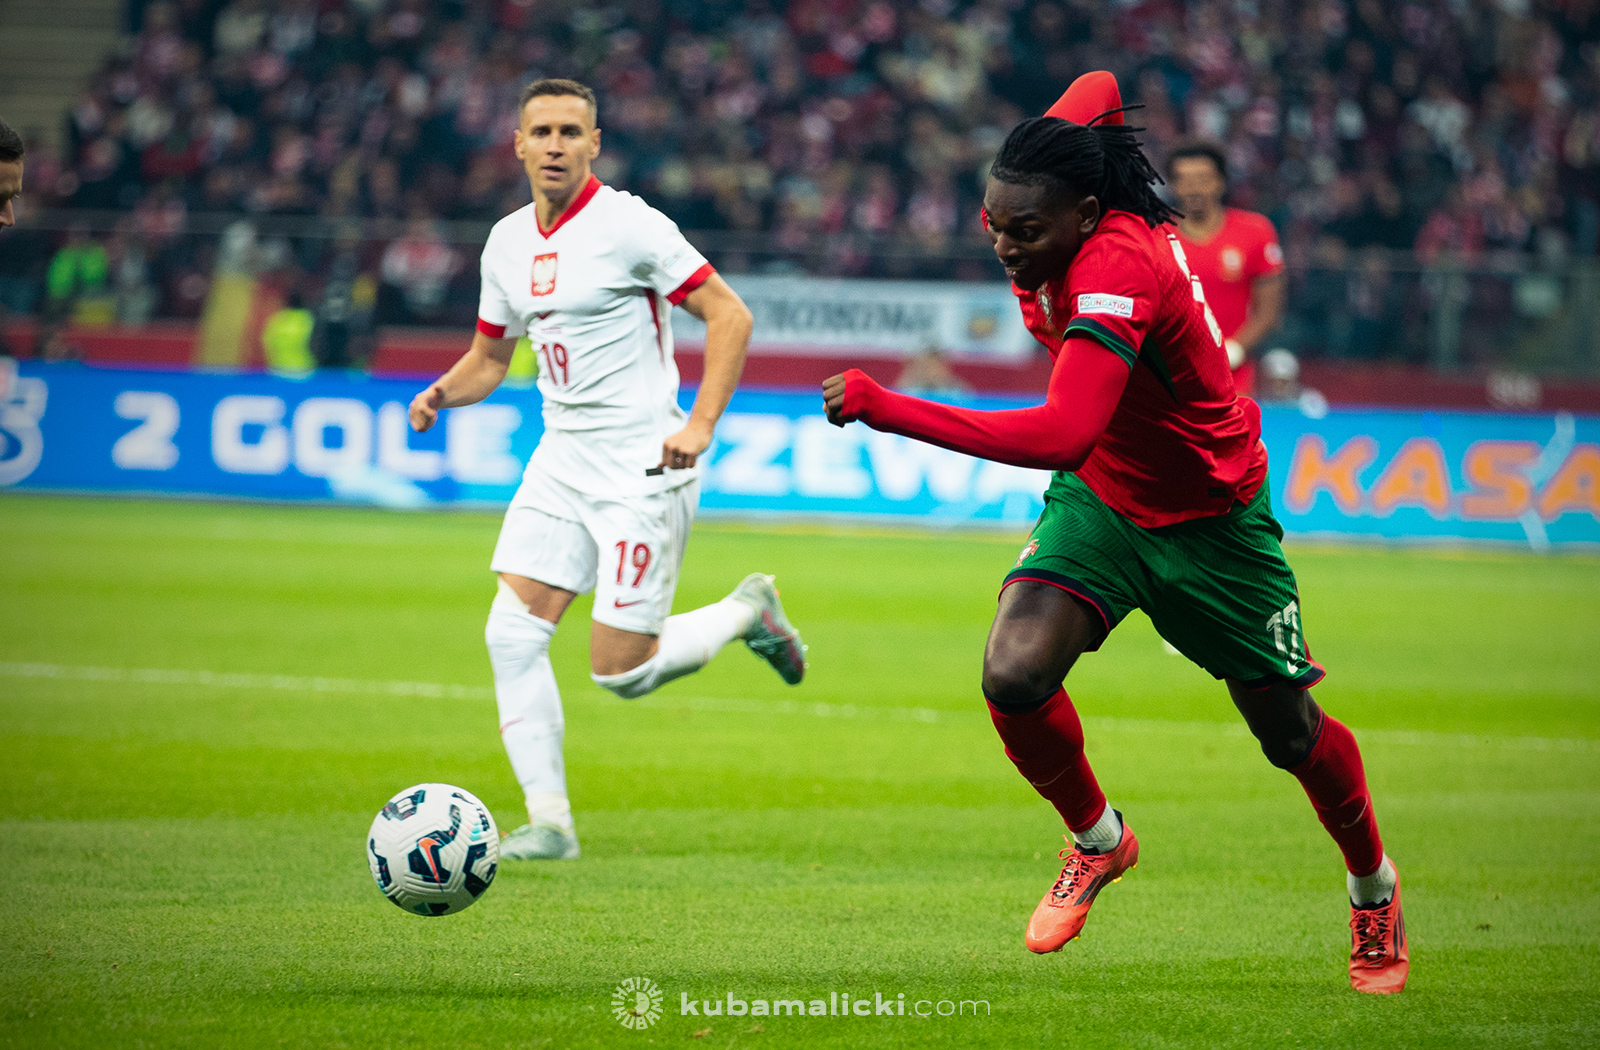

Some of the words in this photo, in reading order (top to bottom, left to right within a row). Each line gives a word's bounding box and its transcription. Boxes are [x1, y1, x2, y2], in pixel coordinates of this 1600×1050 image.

[1079, 300, 1132, 311] FOUNDATION
[540, 343, 569, 387] 19
[112, 390, 180, 470] 2
[211, 395, 523, 484] GOLE
[615, 540, 652, 588] 19
[1266, 600, 1298, 660] 17
